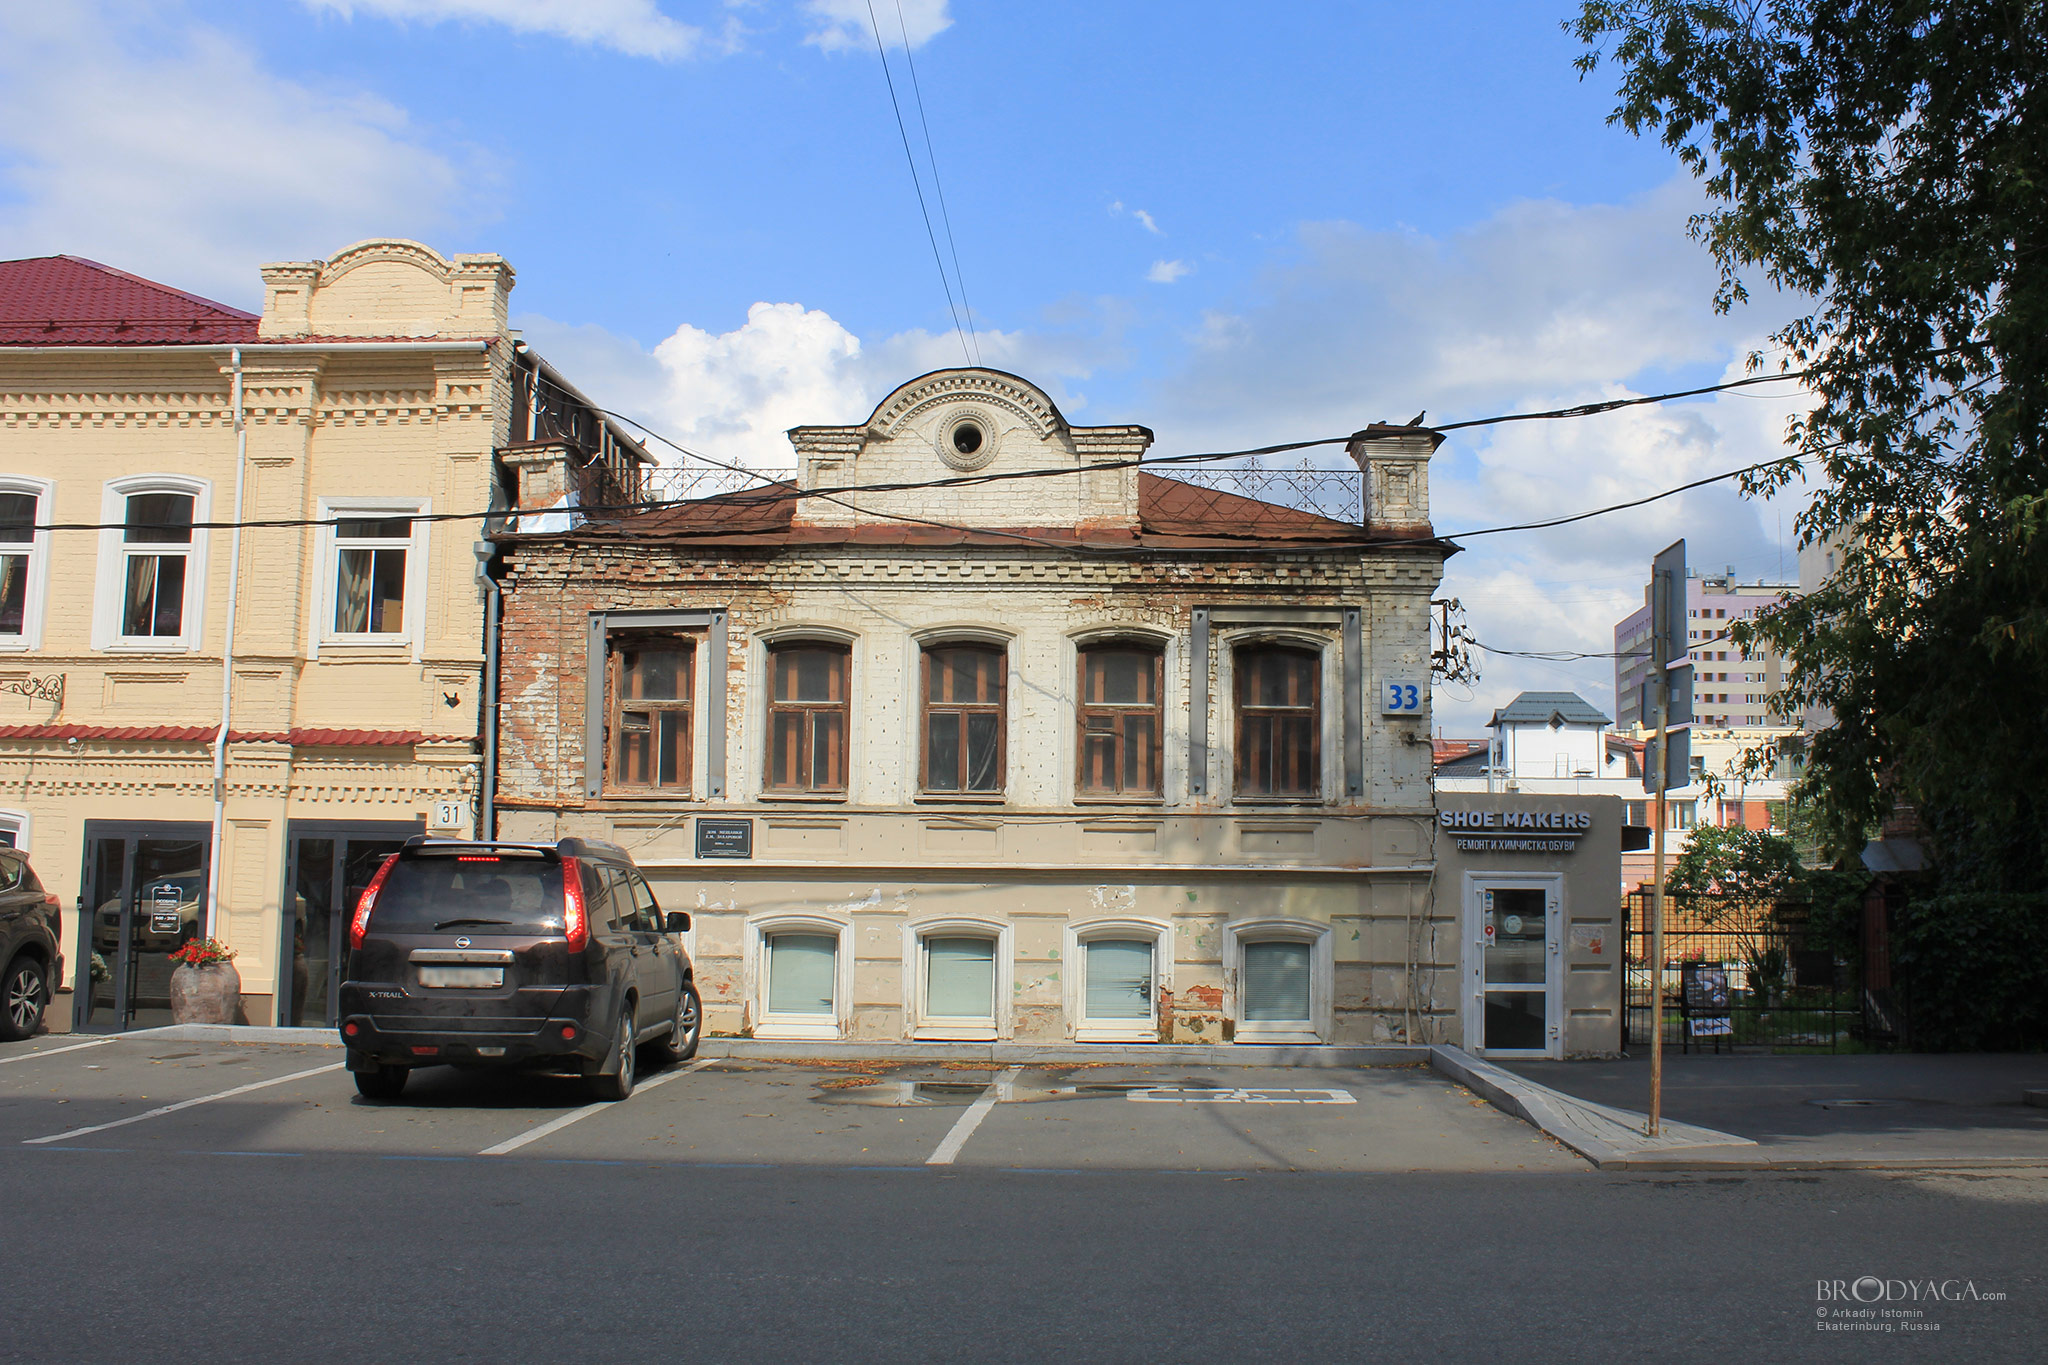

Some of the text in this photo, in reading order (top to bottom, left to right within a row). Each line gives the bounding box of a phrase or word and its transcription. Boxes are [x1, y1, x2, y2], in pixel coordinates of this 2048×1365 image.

[1388, 684, 1419, 710] 33
[442, 805, 458, 823] 31
[1440, 810, 1591, 828] SHOE MAKERS
[1457, 839, 1575, 851] РЕМОНТ И ХИМЧИСТКА ОБУВИ
